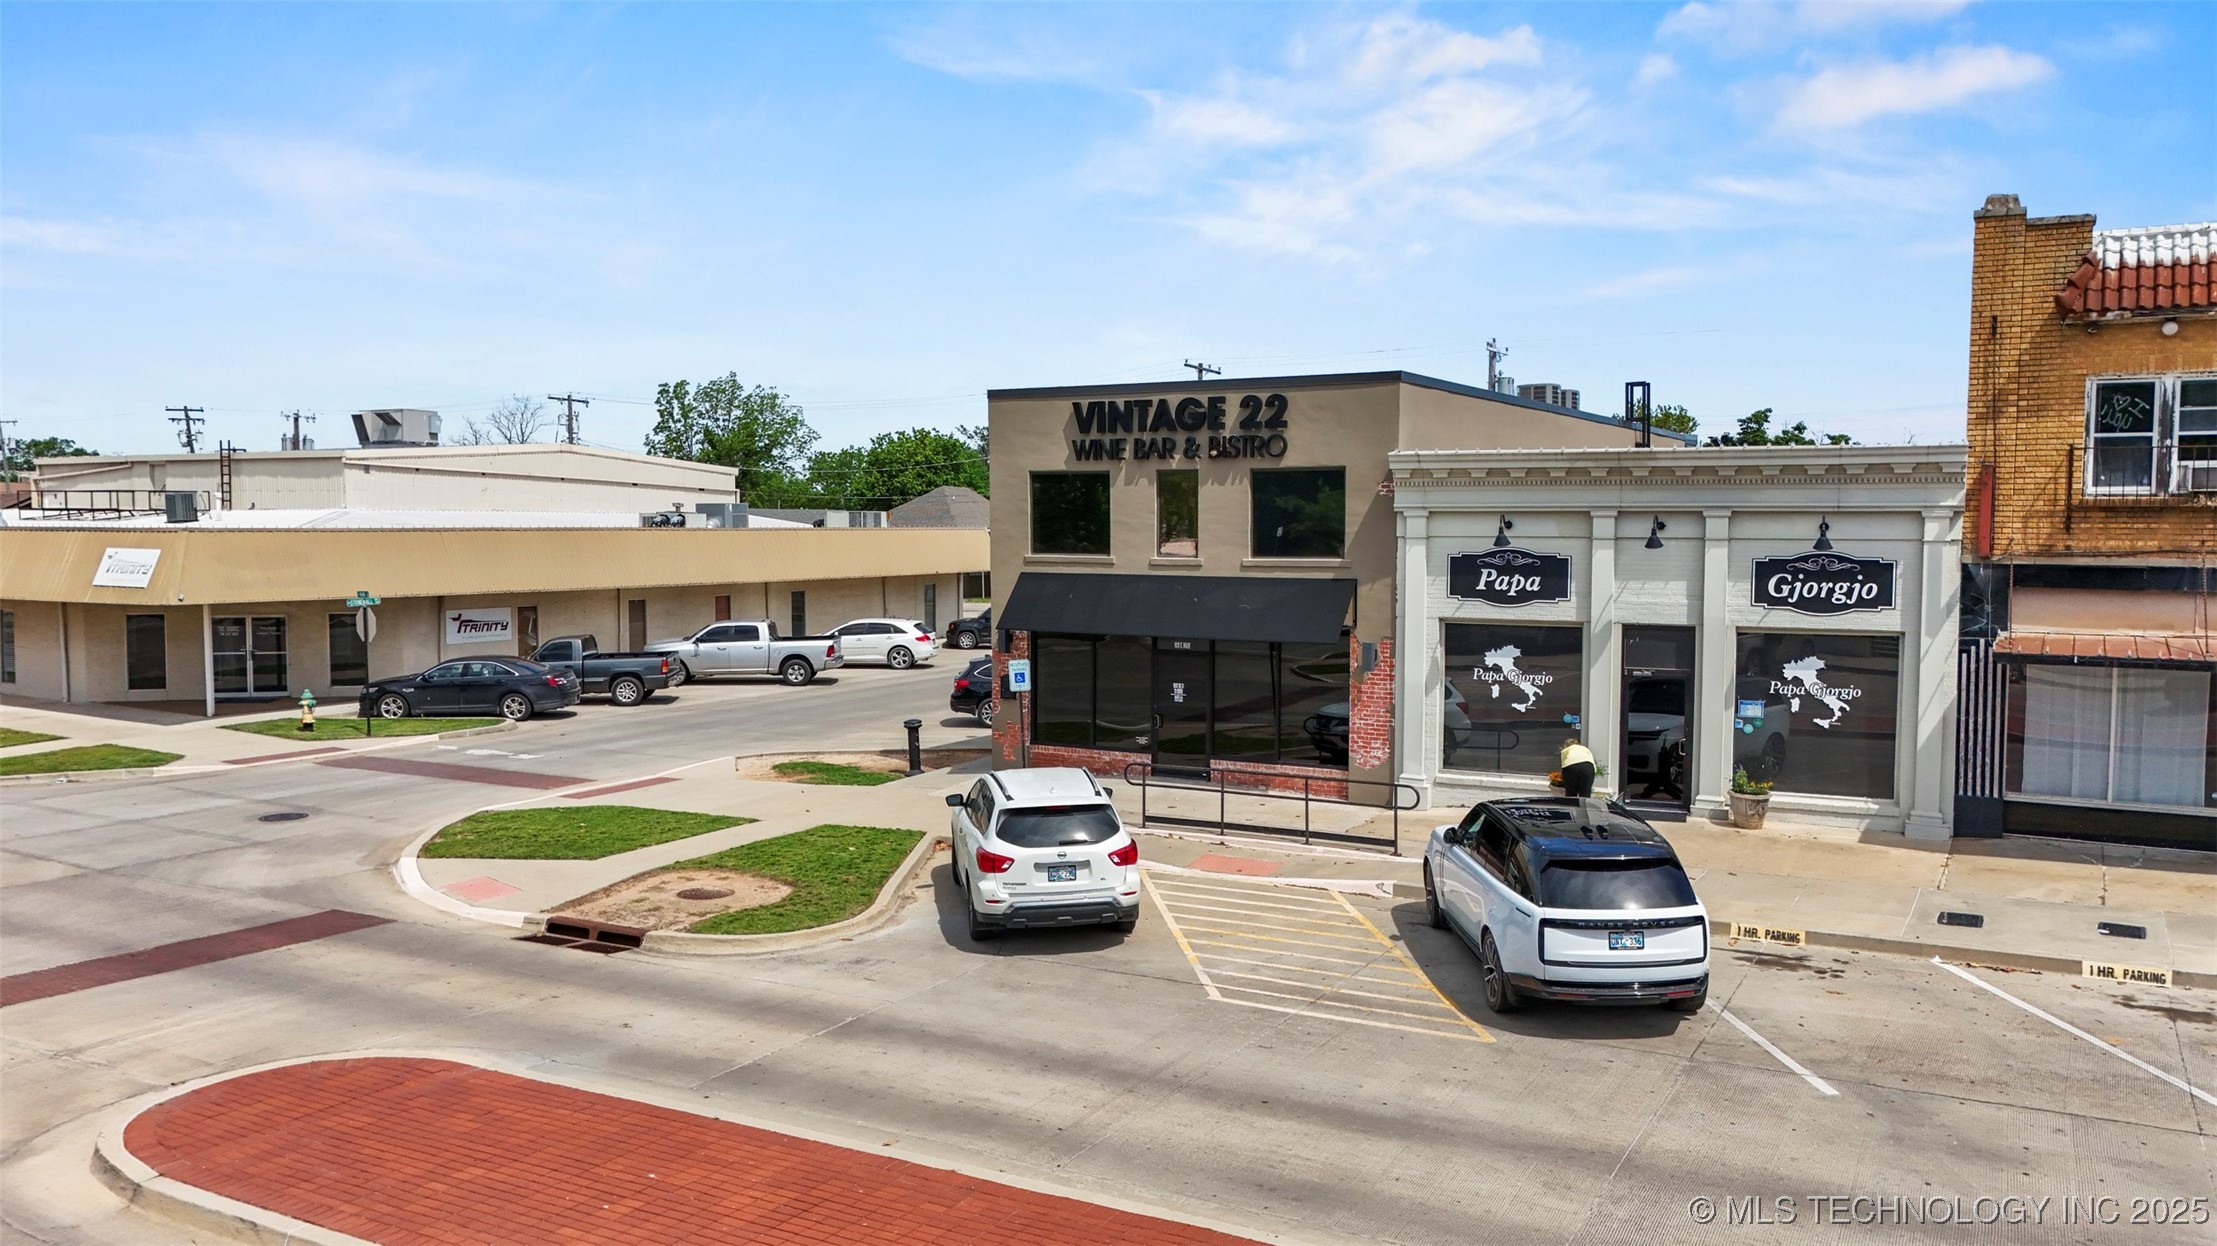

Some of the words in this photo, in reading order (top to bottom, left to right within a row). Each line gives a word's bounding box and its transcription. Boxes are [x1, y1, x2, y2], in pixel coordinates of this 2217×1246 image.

[1072, 396, 1227, 434] VINTAGE
[1239, 393, 1289, 431] 22
[1072, 438, 1127, 461] WINE
[1133, 437, 1176, 460] BAR
[1183, 436, 1202, 459] &
[1208, 434, 1289, 459] BISTRO
[1475, 568, 1541, 596] Papa
[1767, 573, 1878, 604] Gjorgjo
[457, 619, 509, 634] TRINITY
[1473, 667, 1504, 684] Papa
[1507, 668, 1553, 686] Gjorgjo
[1769, 680, 1806, 698] Papa
[1809, 681, 1862, 700] Gjorgjo
[1737, 925, 1741, 937] 1
[1743, 926, 1761, 939] HR.
[1764, 929, 1801, 944] PARKING
[2090, 965, 2094, 976] 1
[2097, 966, 2118, 979] HR.
[2123, 969, 2166, 984] PARKING
